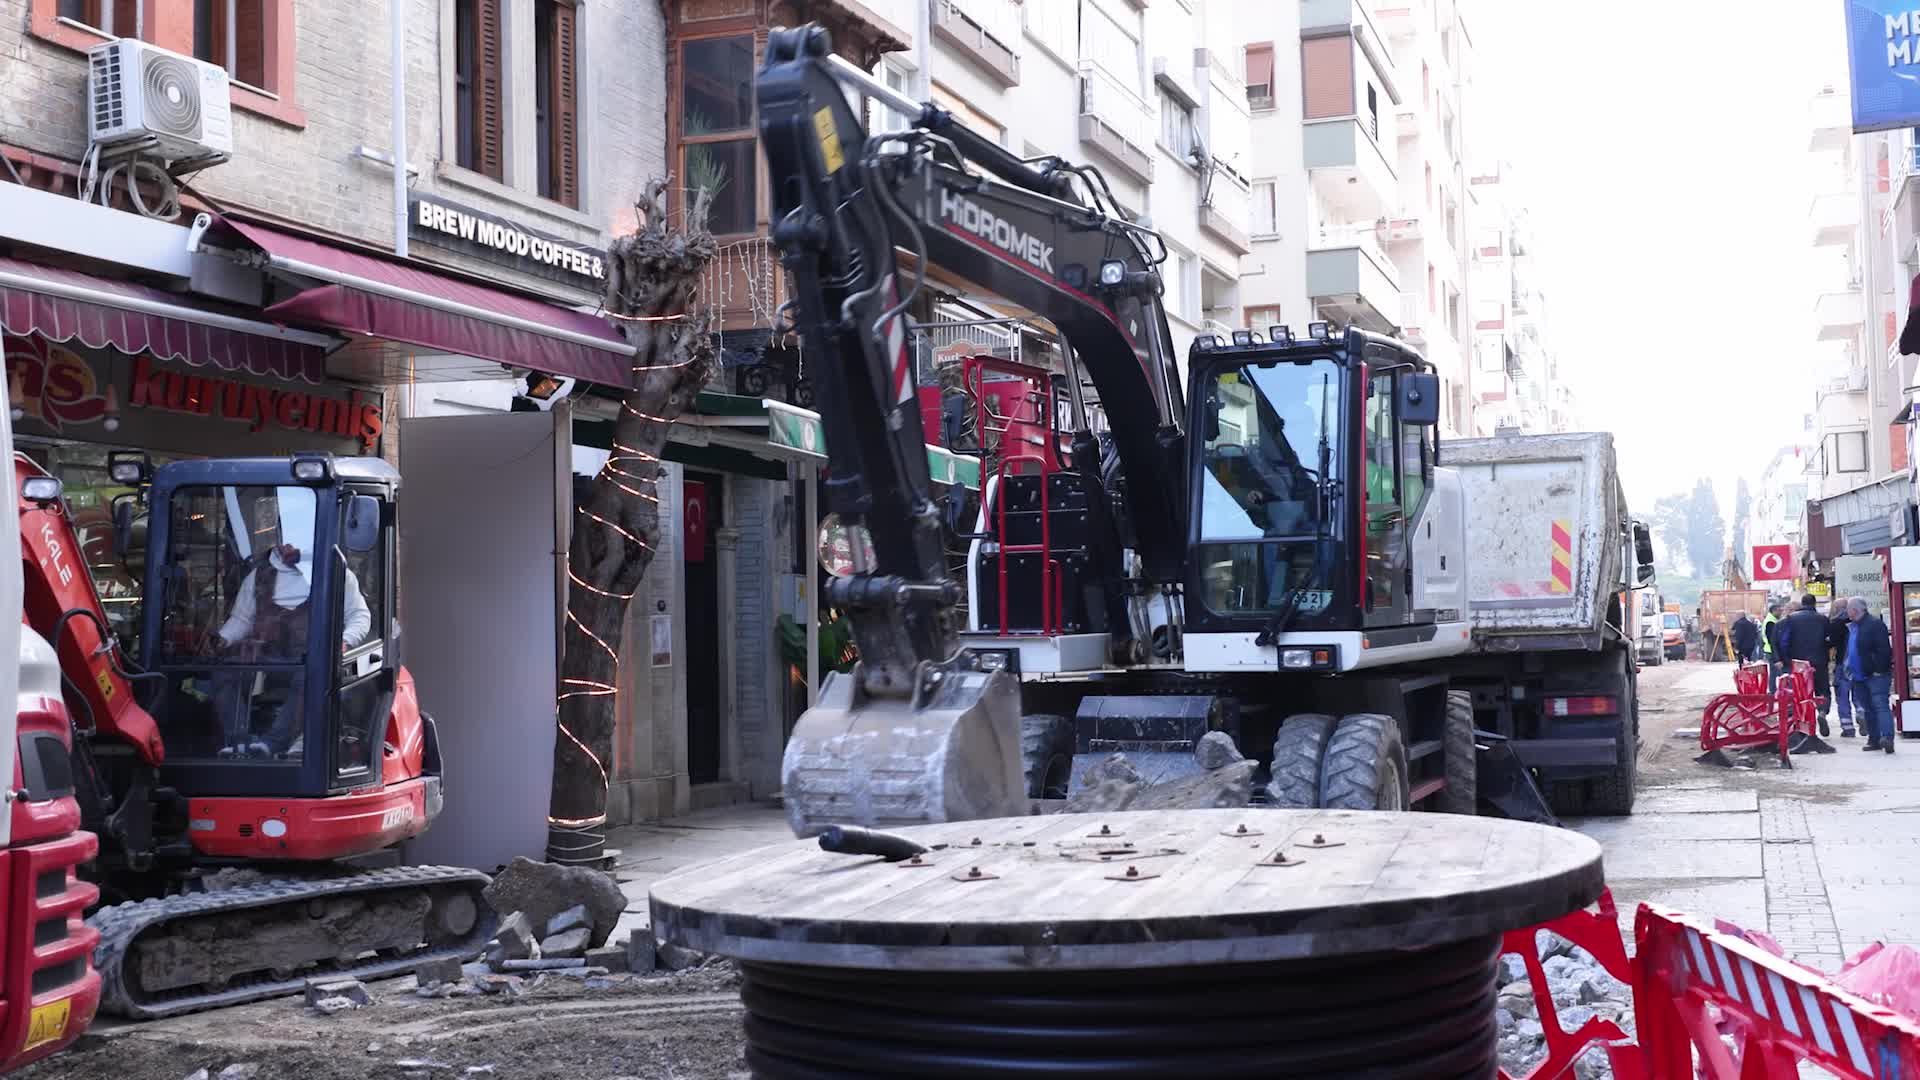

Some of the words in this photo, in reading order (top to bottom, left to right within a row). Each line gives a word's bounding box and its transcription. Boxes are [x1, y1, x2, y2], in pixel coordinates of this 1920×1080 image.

[419, 199, 476, 241] BREW
[478, 220, 529, 257] MOOD
[530, 237, 591, 276] COFFEE
[41, 522, 73, 587] KALE
[1858, 572, 1883, 582] BARGE
